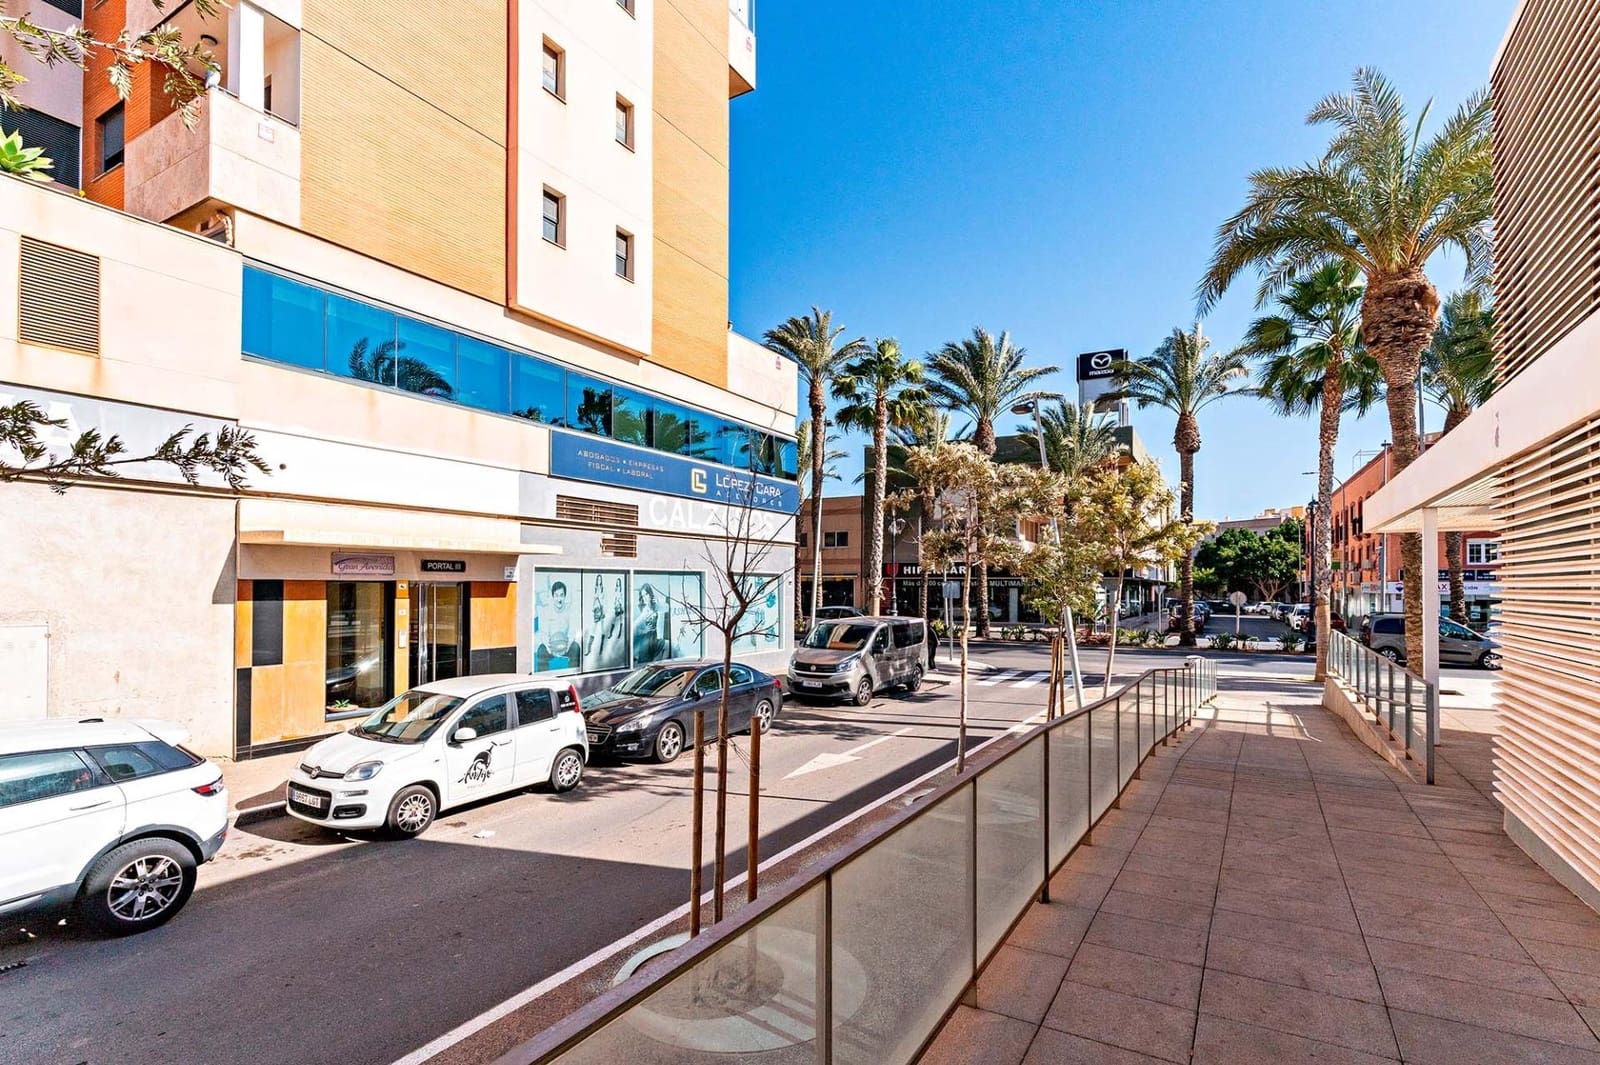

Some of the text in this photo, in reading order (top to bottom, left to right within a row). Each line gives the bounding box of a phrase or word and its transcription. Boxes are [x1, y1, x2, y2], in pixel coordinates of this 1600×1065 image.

[1089, 369, 1114, 377] mazda
[577, 449, 620, 464] ABOGADOS
[588, 461, 654, 480] FISCAL LABORAL
[648, 497, 776, 537] CALZOS
[427, 562, 454, 570] PORTAL
